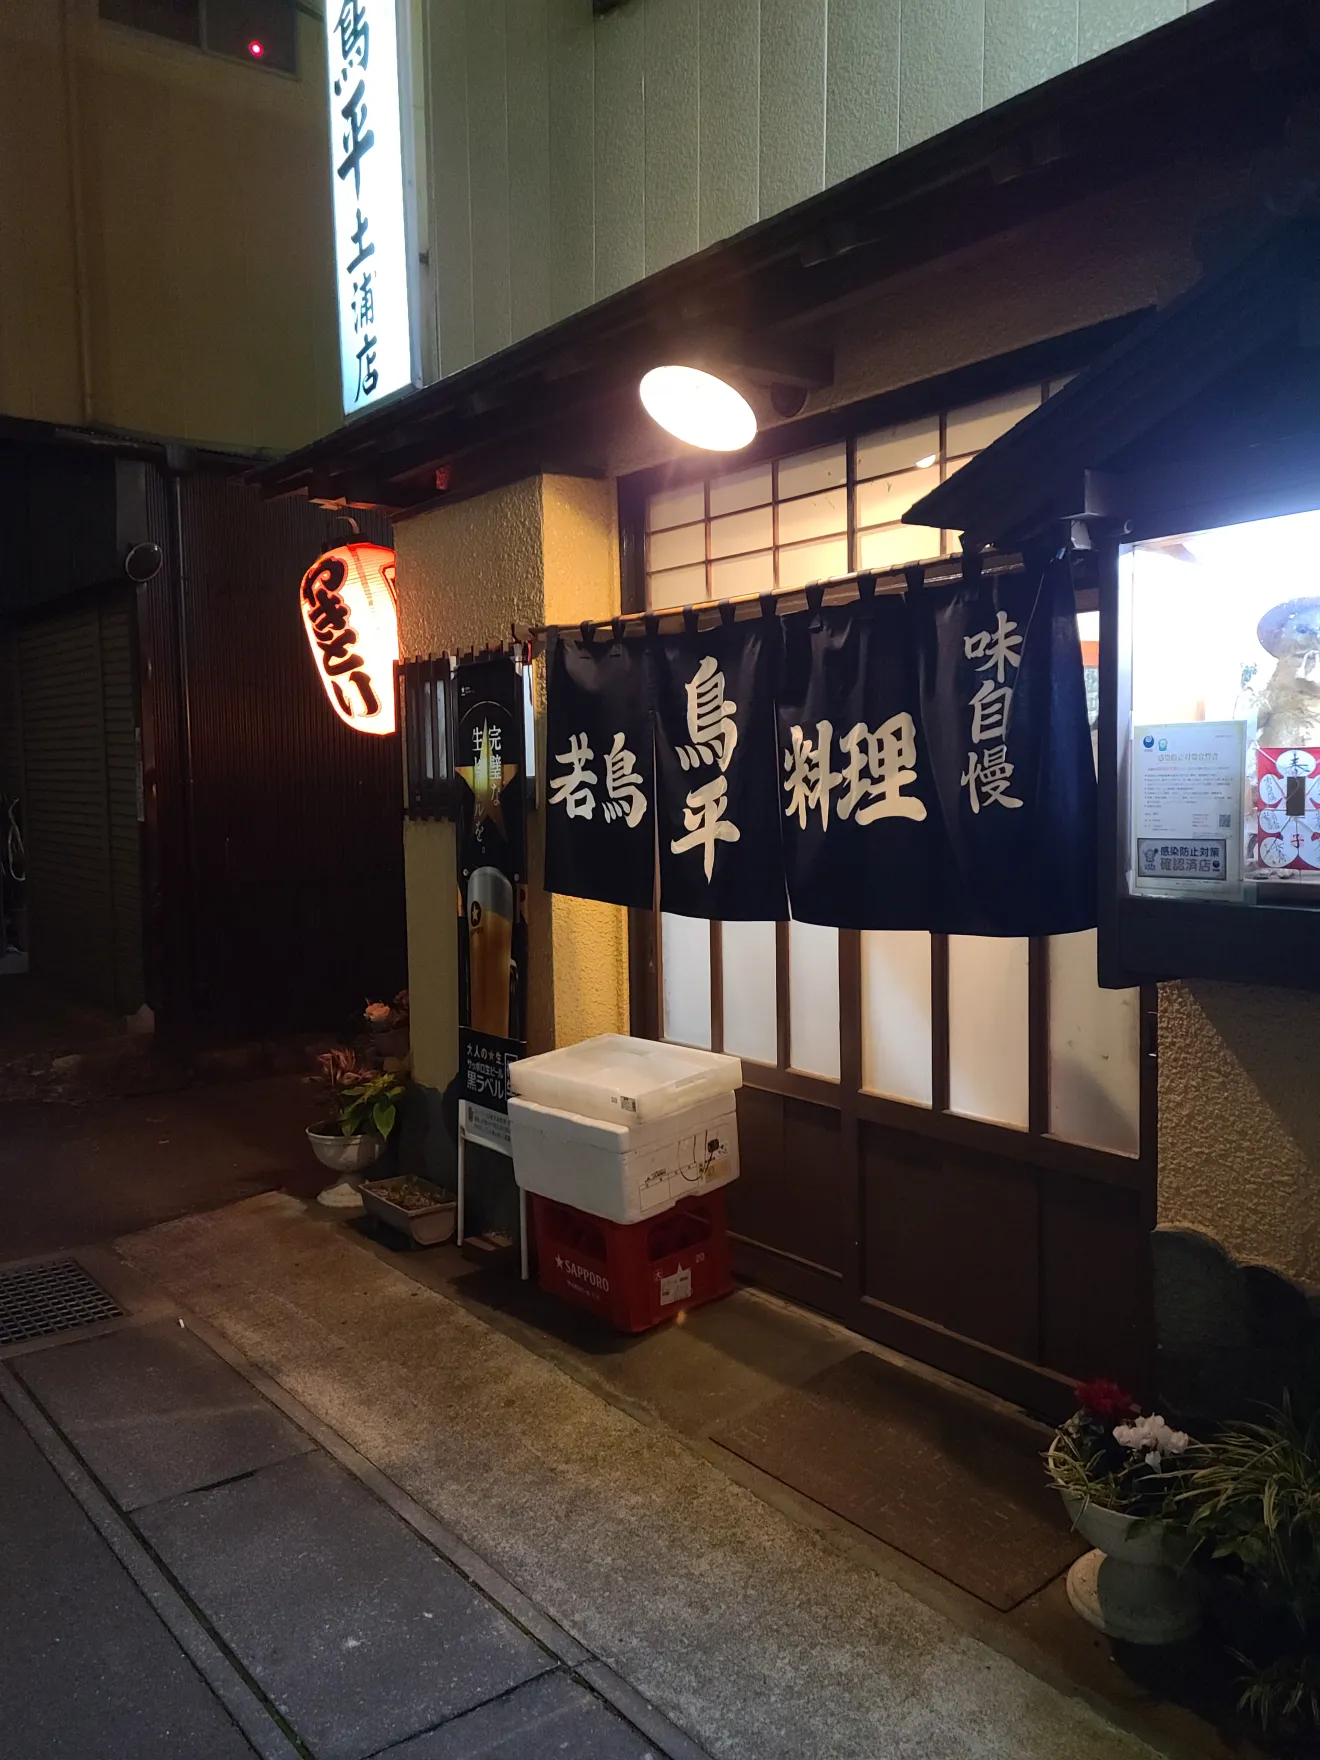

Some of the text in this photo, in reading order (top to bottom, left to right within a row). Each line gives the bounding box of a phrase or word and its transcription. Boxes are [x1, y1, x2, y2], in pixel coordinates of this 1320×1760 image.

[346, 208, 379, 403] 土浦店
[302, 545, 381, 717] やきとり
[960, 612, 1024, 814] 味自慢
[548, 731, 648, 828] 若鳥
[670, 655, 741, 885] 鳥平
[783, 711, 928, 832] 料理
[1160, 846, 1220, 858] 感染防止対策
[1160, 857, 1212, 872] 確認済店
[466, 1069, 504, 1100] 黒ラベル
[564, 1259, 610, 1292] SAPPORO
